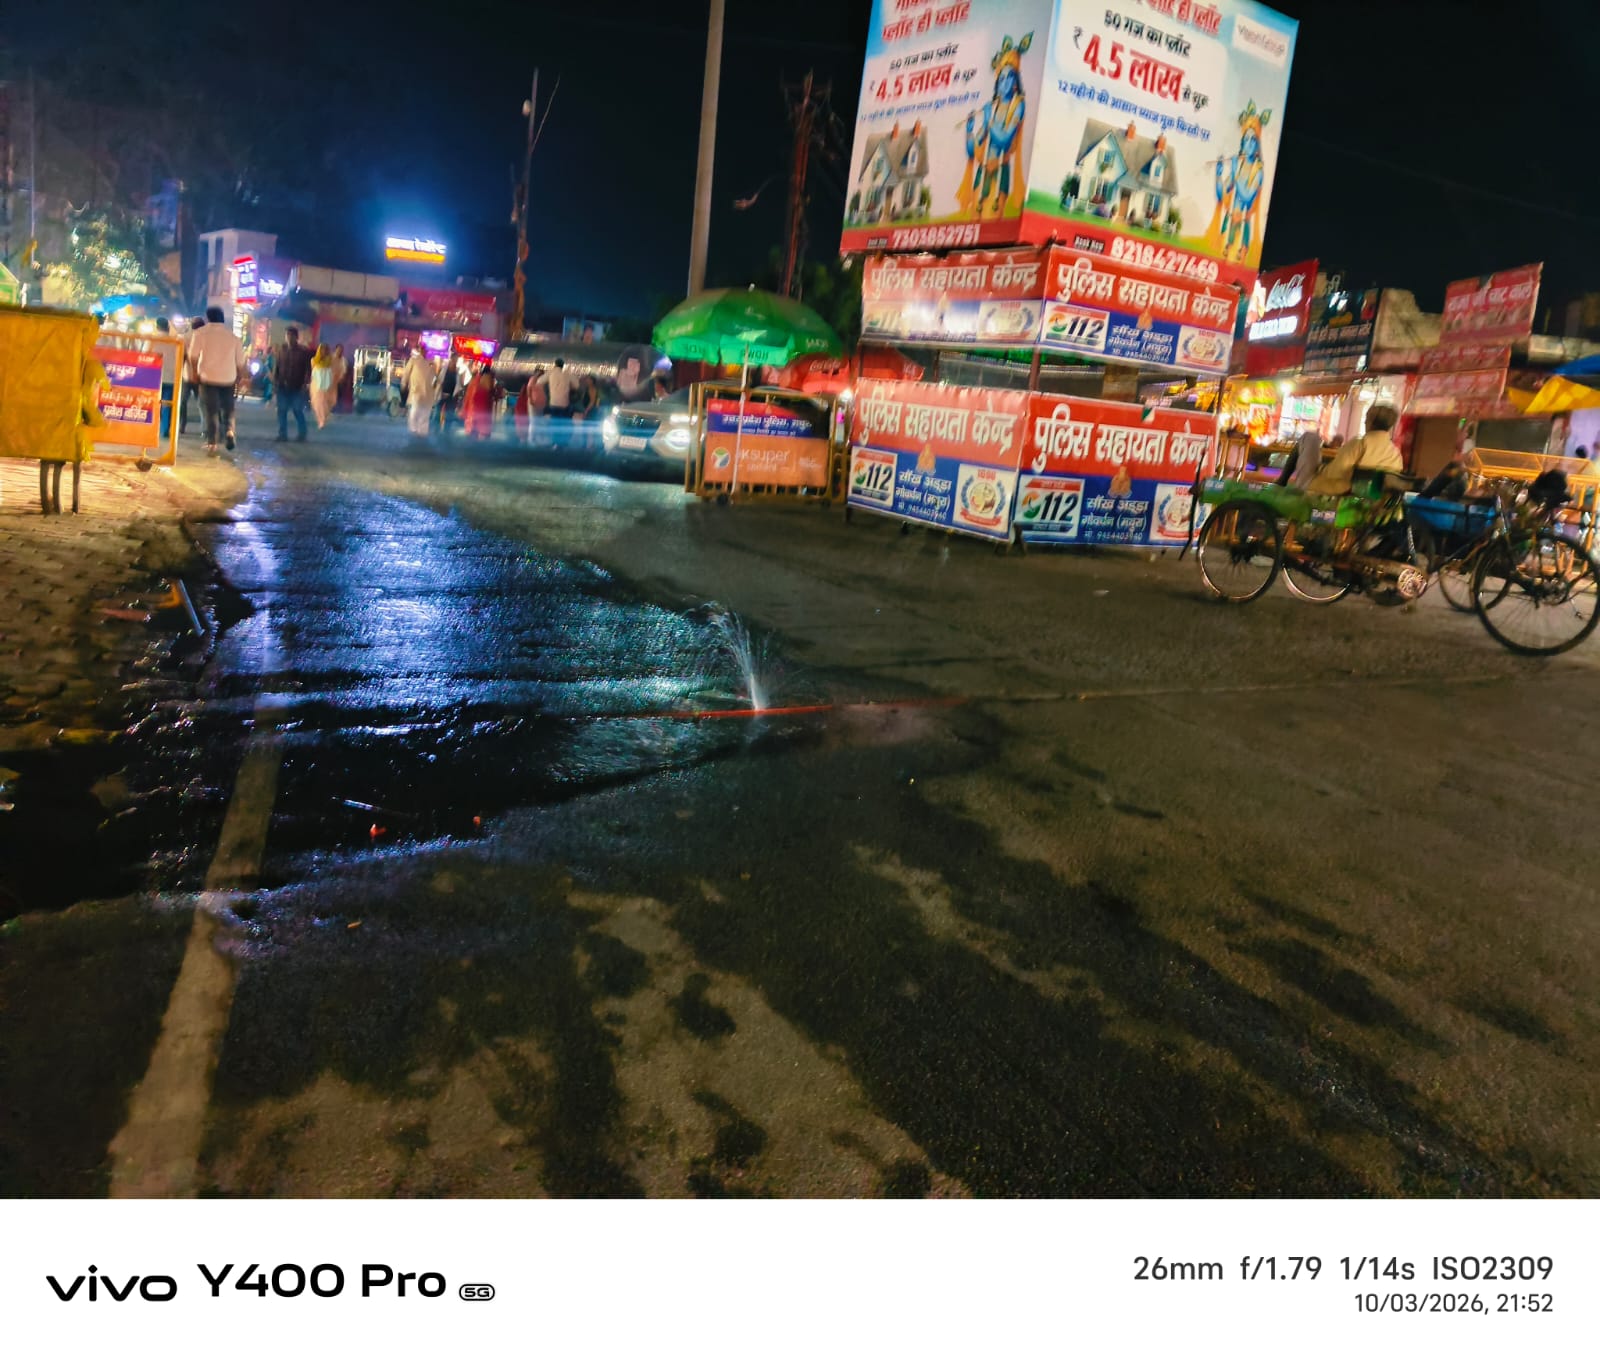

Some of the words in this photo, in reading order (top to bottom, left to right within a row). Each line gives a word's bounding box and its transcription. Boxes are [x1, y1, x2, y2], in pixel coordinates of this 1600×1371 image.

[1123, 16, 1145, 40] गज
[1146, 26, 1163, 47] का
[1164, 33, 1191, 58] प्लॉट
[876, 73, 906, 103] 4.5
[908, 63, 955, 94] लाख
[1083, 34, 1124, 81] 4.5
[1128, 49, 1184, 103] लाख
[869, 257, 918, 299] पुलिस
[919, 264, 990, 290] सहायता
[1111, 236, 1219, 284] 8218427469
[1056, 257, 1117, 303] पुलिस
[1119, 276, 1190, 313] सहायता
[1191, 286, 1232, 329] केन्द्र
[1067, 316, 1104, 342] 112
[860, 385, 903, 447] पुलिस
[904, 403, 970, 444] सहायता
[972, 394, 1018, 457] केन्द्र
[1032, 402, 1095, 473] पुलिस
[1096, 422, 1170, 465] सहायता
[865, 462, 893, 492] 112
[1040, 490, 1079, 522] 112
